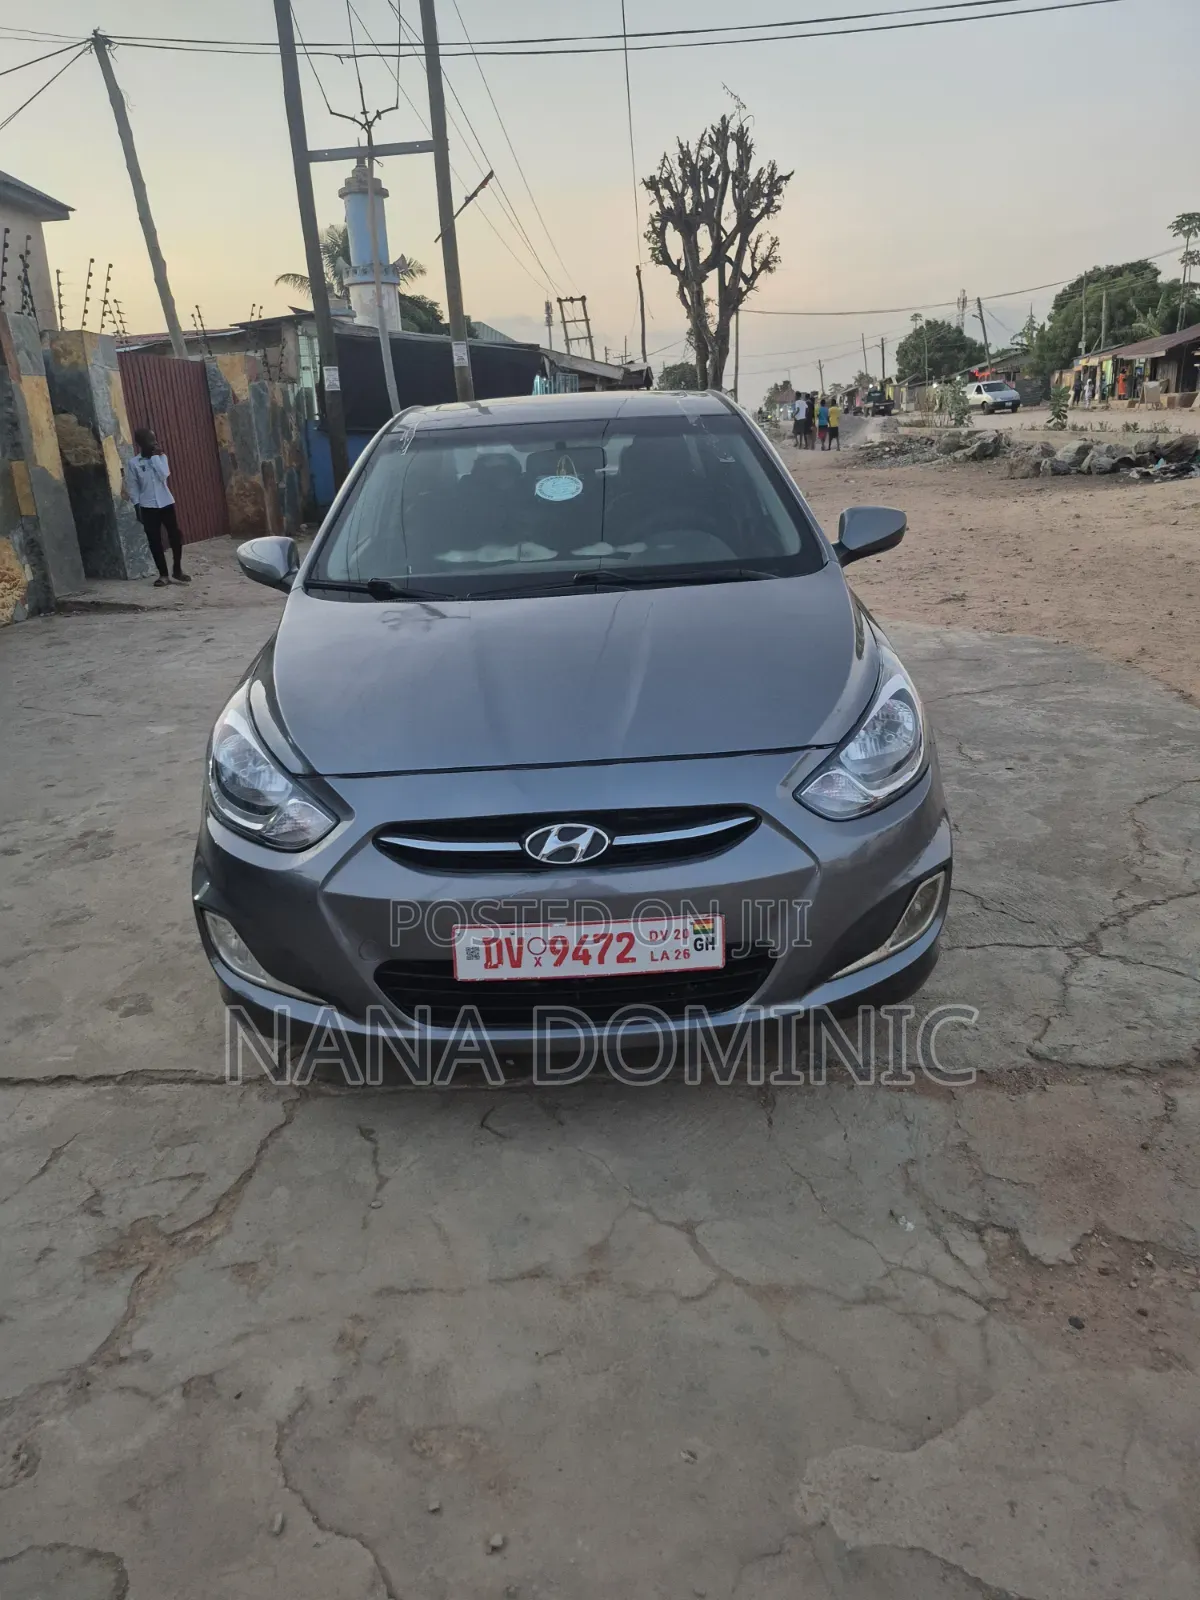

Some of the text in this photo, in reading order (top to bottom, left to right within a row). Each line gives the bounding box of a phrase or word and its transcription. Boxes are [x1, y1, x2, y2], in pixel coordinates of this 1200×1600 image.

[649, 929, 670, 942] DV
[482, 931, 637, 969] DV 9472
[693, 937, 716, 952] GH
[650, 948, 691, 962] LA 26
